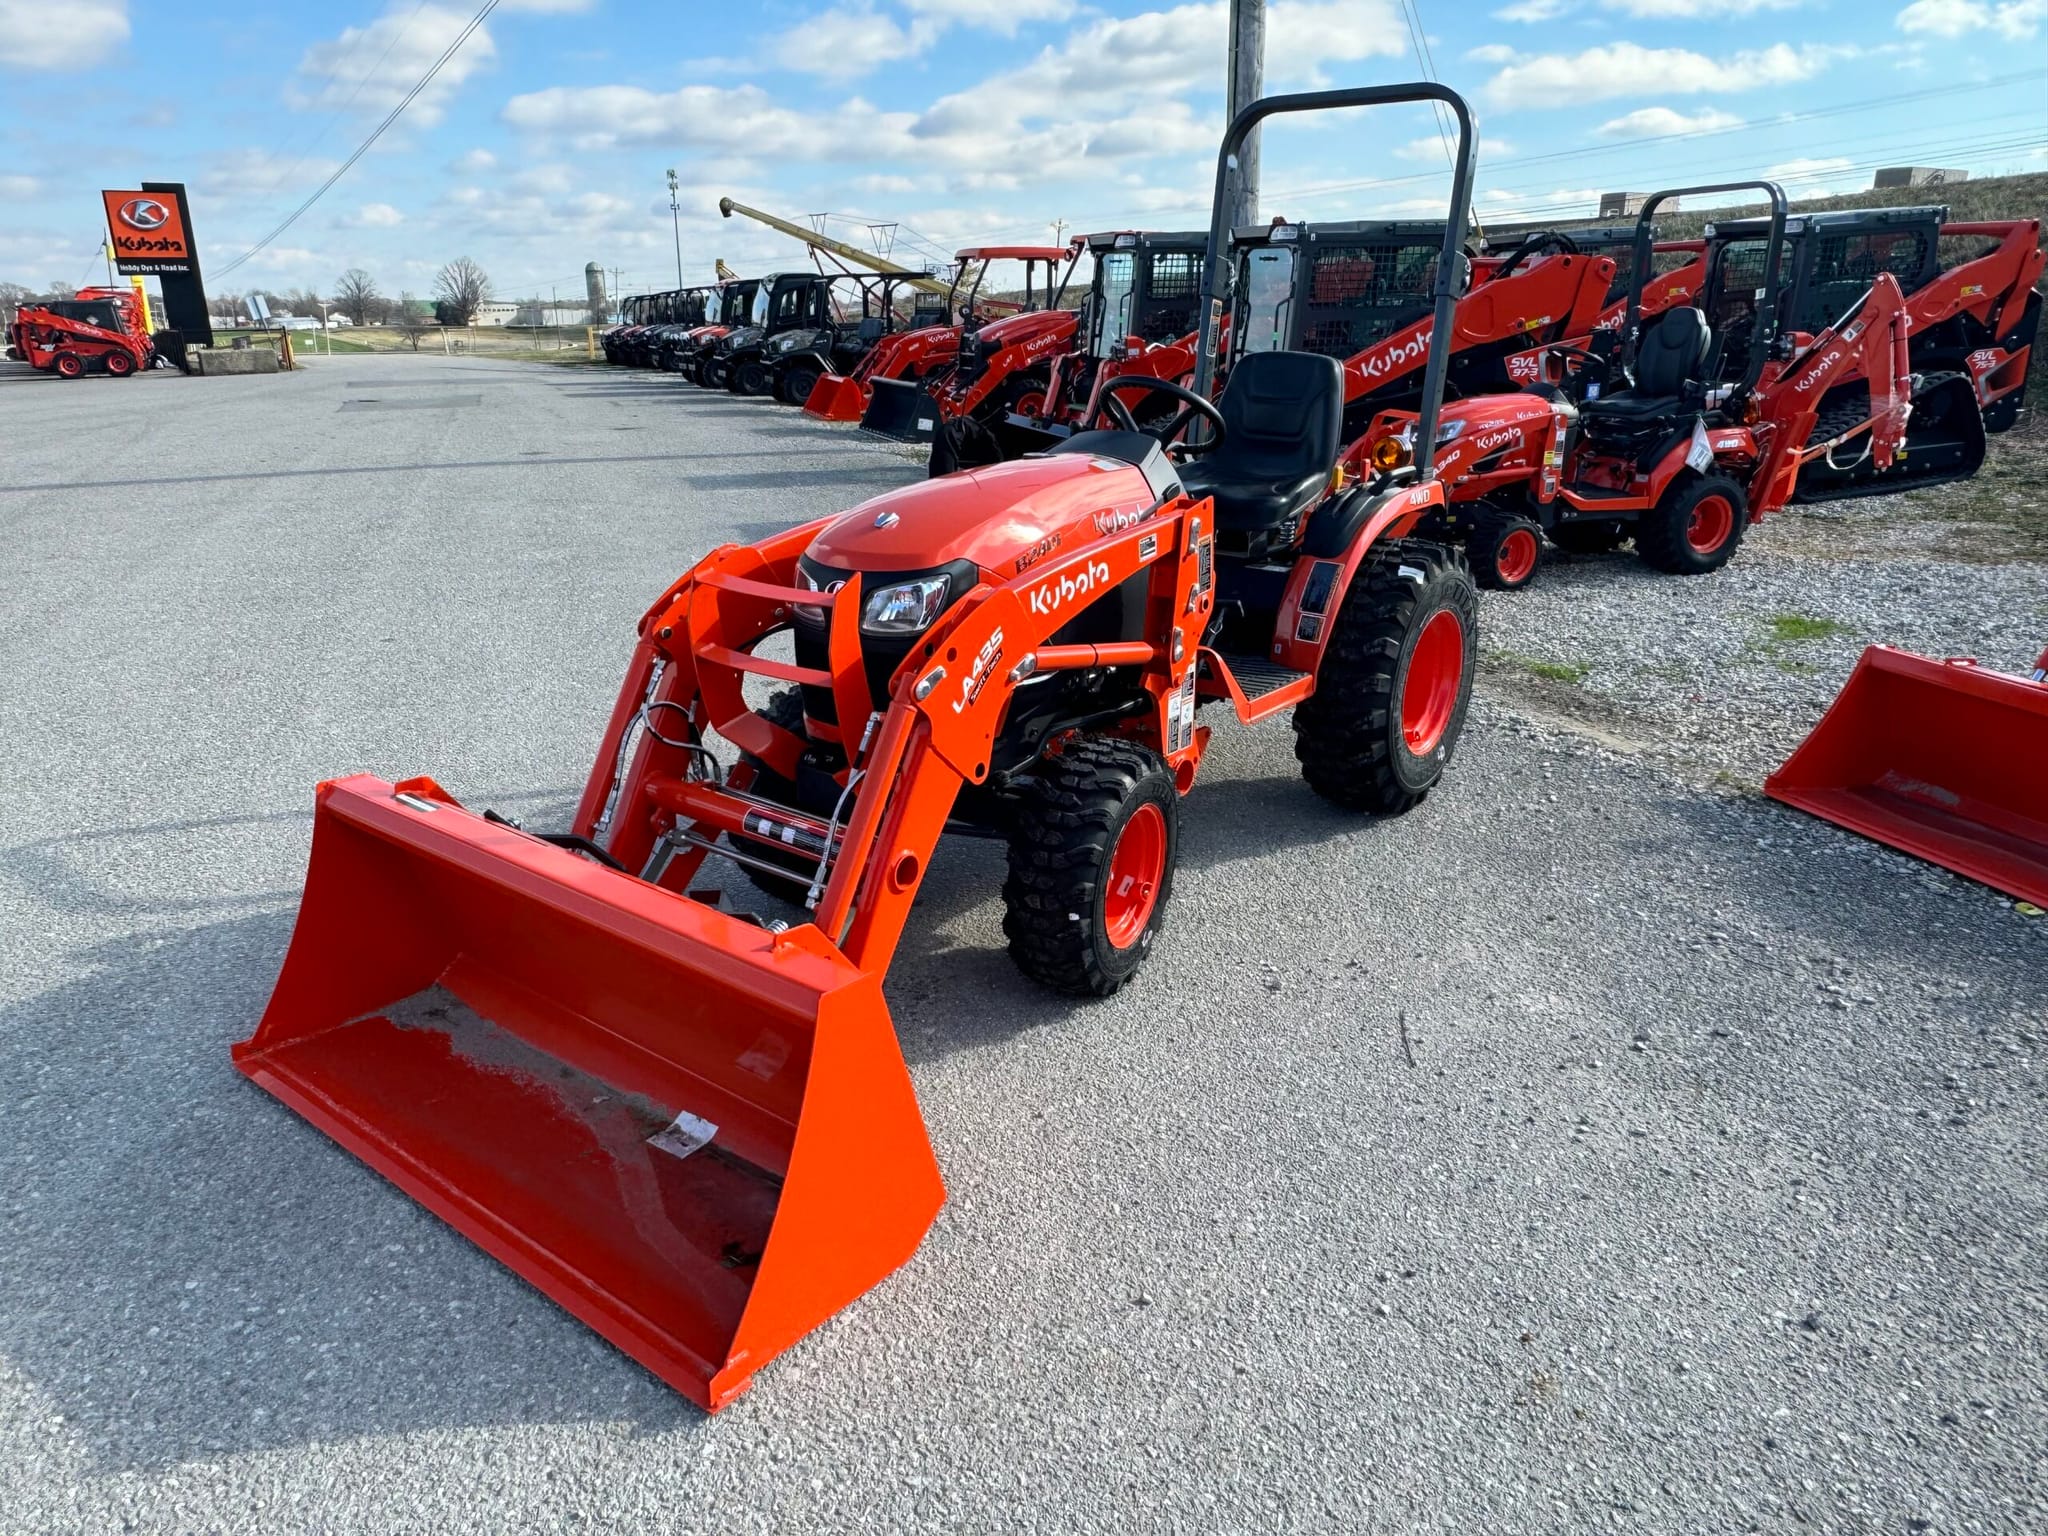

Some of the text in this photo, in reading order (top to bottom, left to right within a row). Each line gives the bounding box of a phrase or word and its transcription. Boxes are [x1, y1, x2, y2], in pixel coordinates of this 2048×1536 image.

[117, 236, 183, 252] Kubota
[927, 331, 955, 343] Kubota
[1026, 334, 1057, 352] Kubota
[1510, 356, 1538, 369] SVL
[1972, 350, 1997, 362] SVL
[1974, 360, 1996, 370] 75-3
[1512, 367, 1538, 377] 97-3
[1793, 350, 1841, 393] Kubota
[1476, 426, 1522, 449] Kubota
[1432, 449, 1461, 479] A340
[1410, 489, 1430, 506] 4WD
[1093, 503, 1146, 536] Kubot
[1030, 559, 1110, 615] Kubota
[952, 624, 1004, 714] LA435
[969, 651, 1002, 703] Swift-Tach
